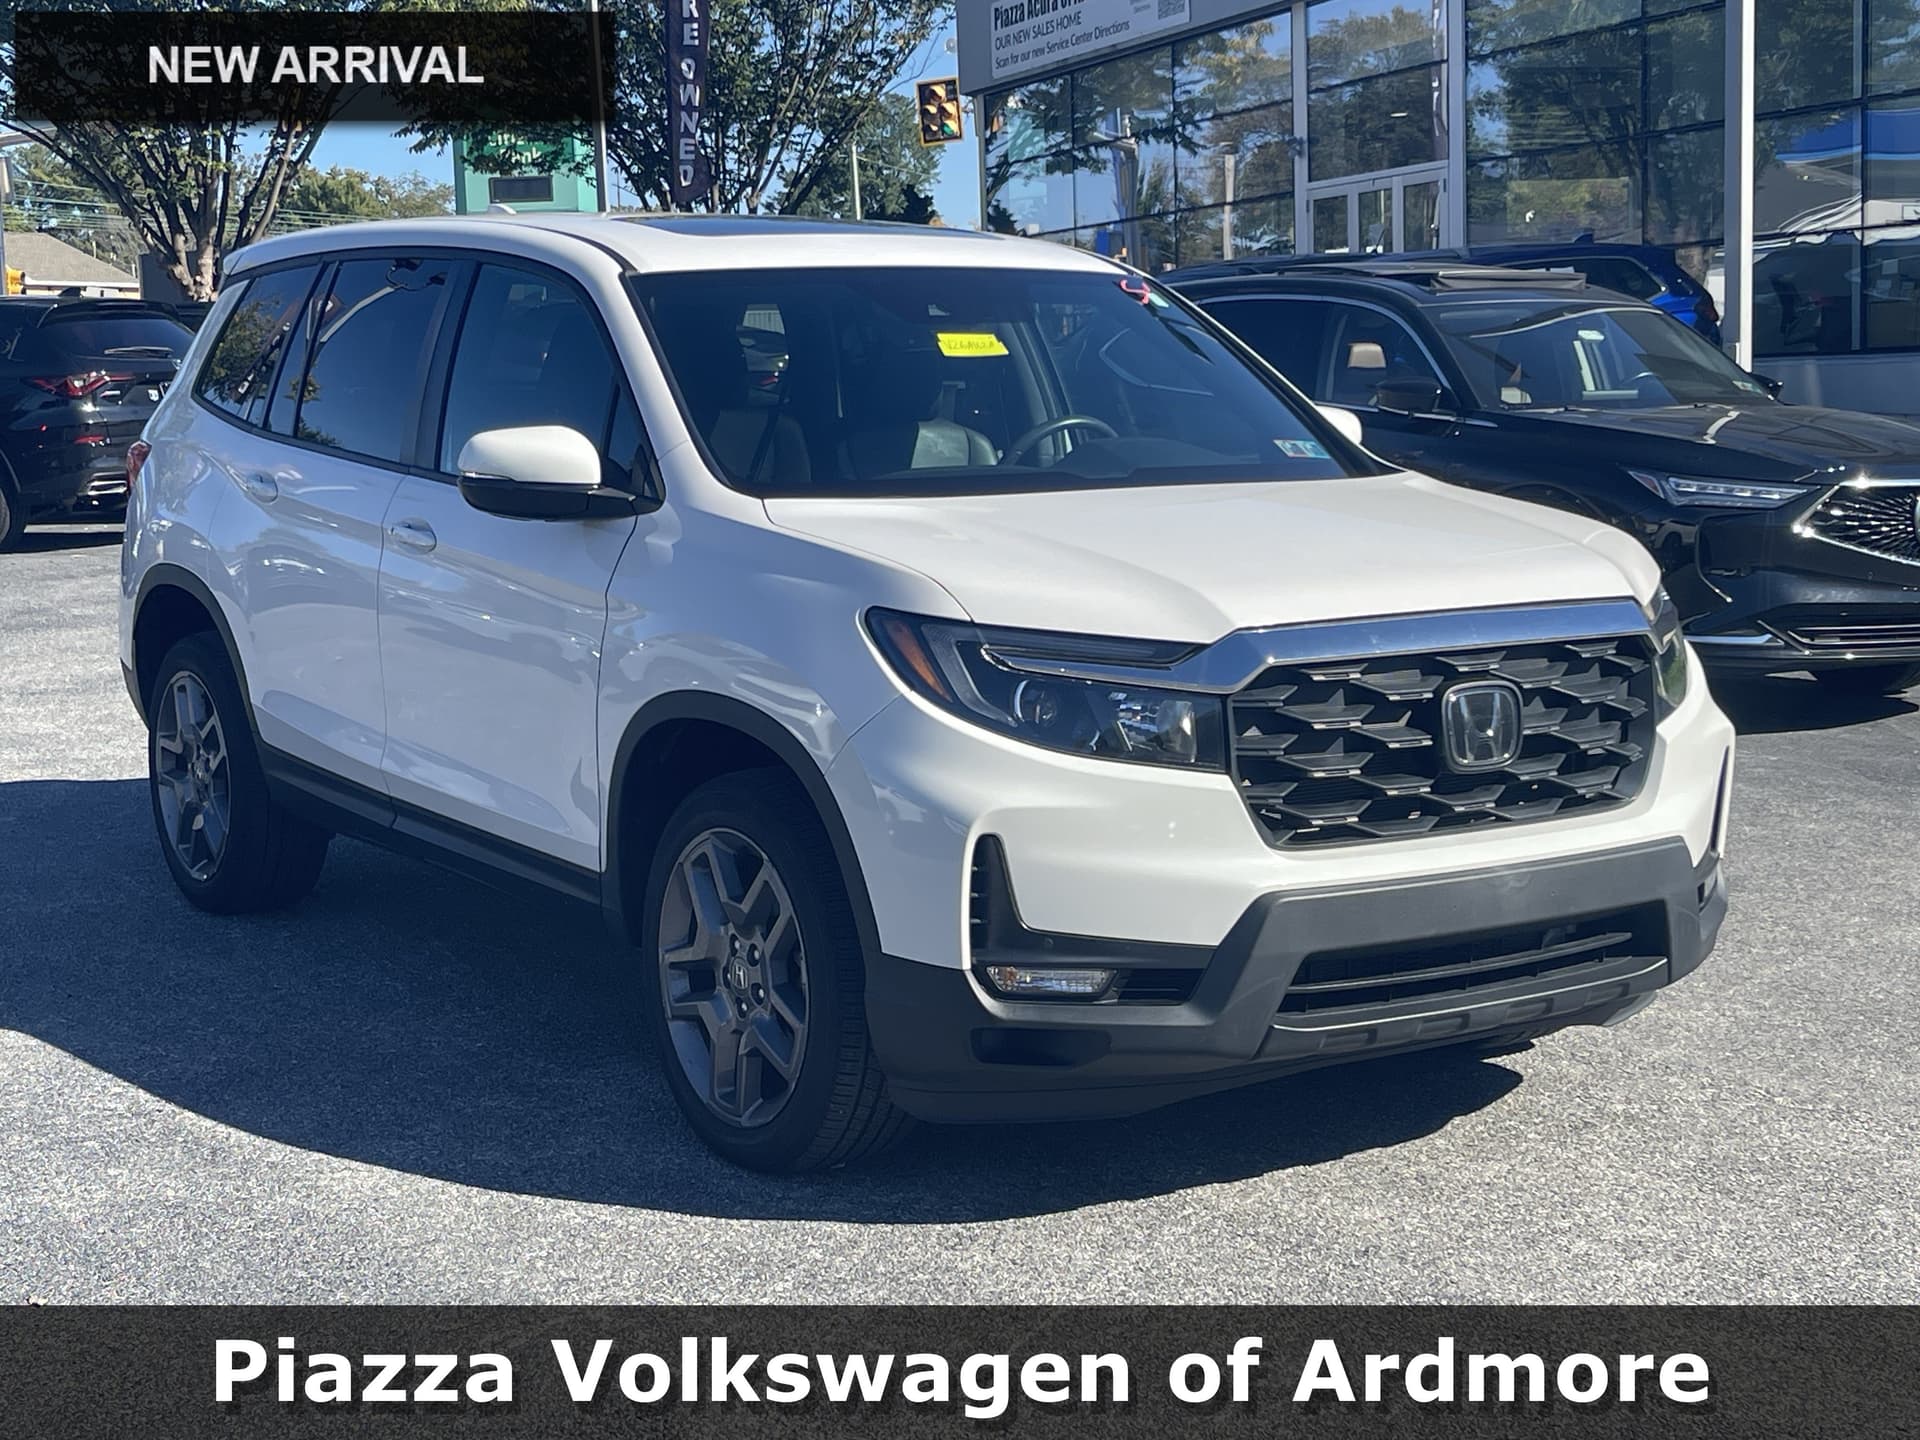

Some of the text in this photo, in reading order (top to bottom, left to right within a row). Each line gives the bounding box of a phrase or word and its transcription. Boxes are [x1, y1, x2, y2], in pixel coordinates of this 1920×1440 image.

[994, 2, 1025, 31] Piazza
[995, 11, 1082, 50] OUR NEW SALES HOME
[995, 57, 1009, 70] Scan
[1010, 53, 1020, 65] for
[1046, 39, 1070, 54] Service
[1070, 31, 1093, 46] Center
[1094, 20, 1130, 40] Directions
[679, 58, 700, 187] OWNED
